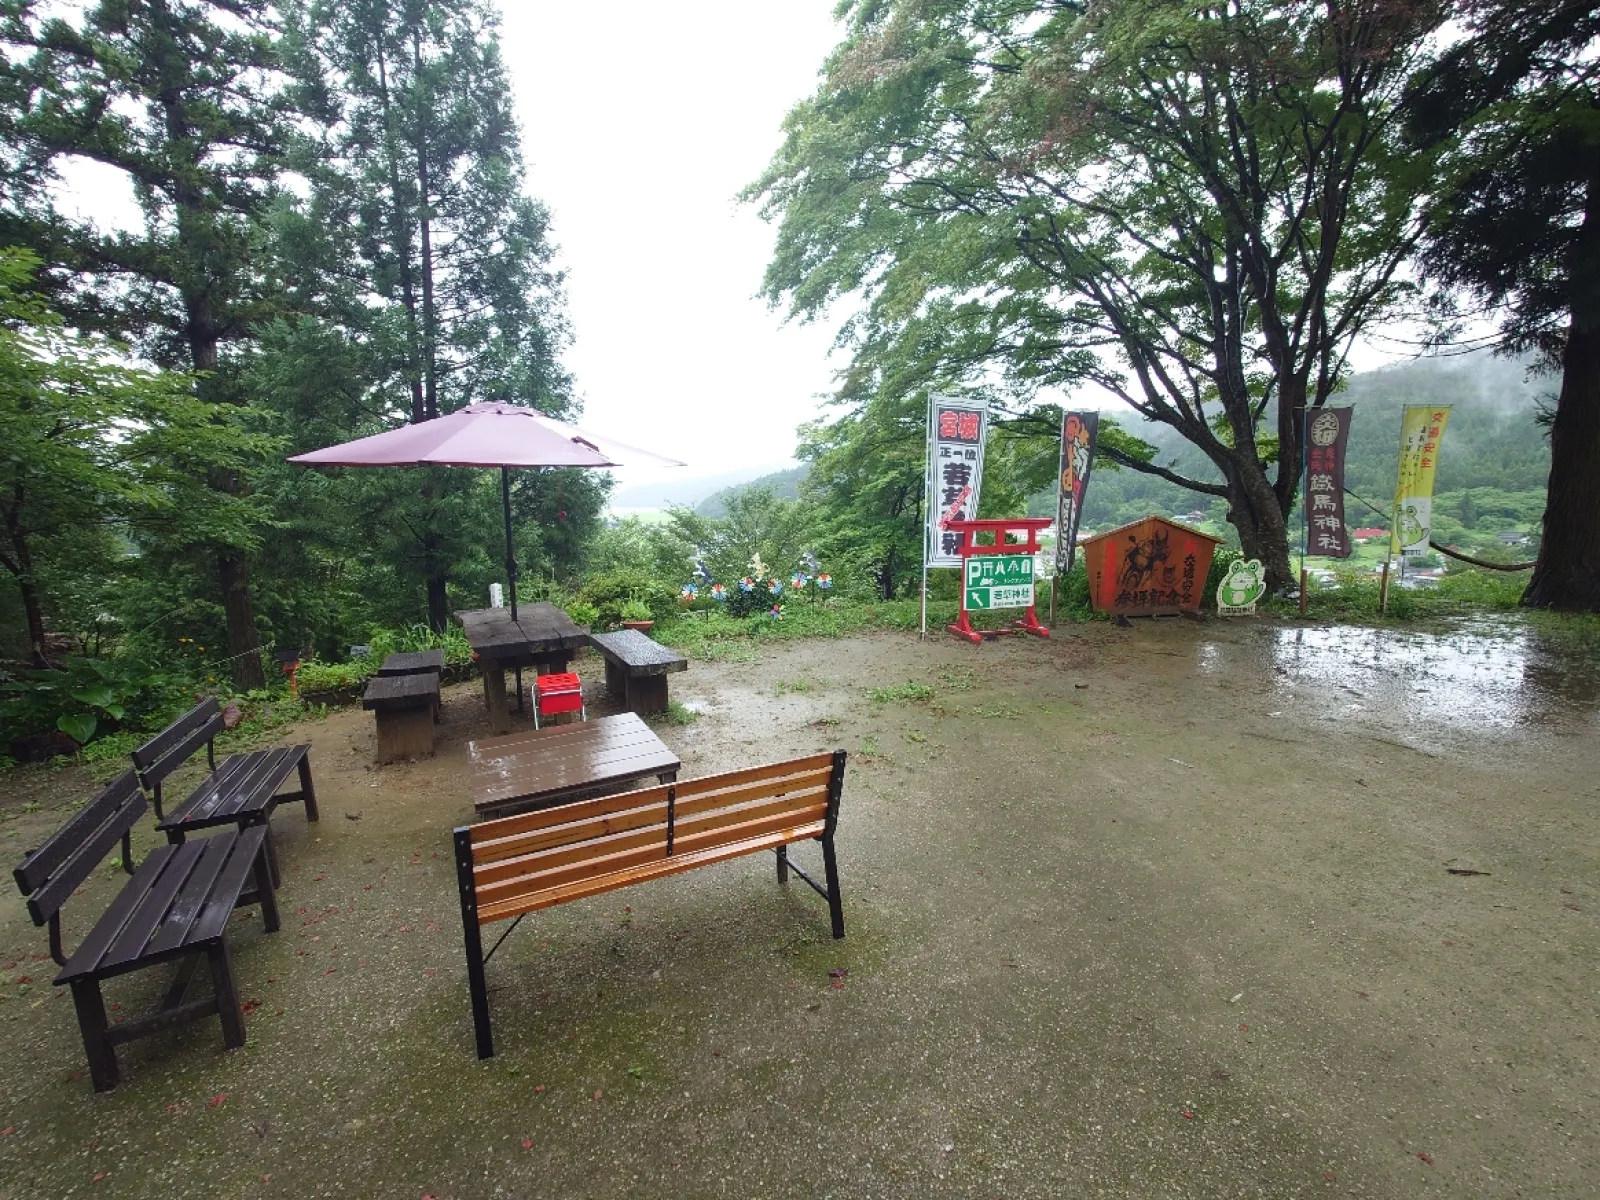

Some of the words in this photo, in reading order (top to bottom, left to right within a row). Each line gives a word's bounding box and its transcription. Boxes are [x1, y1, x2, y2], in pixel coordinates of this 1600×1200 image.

[940, 410, 979, 440] 宮城
[1420, 411, 1444, 468] 交通安全
[940, 447, 977, 460] 正一位
[969, 561, 981, 586] P
